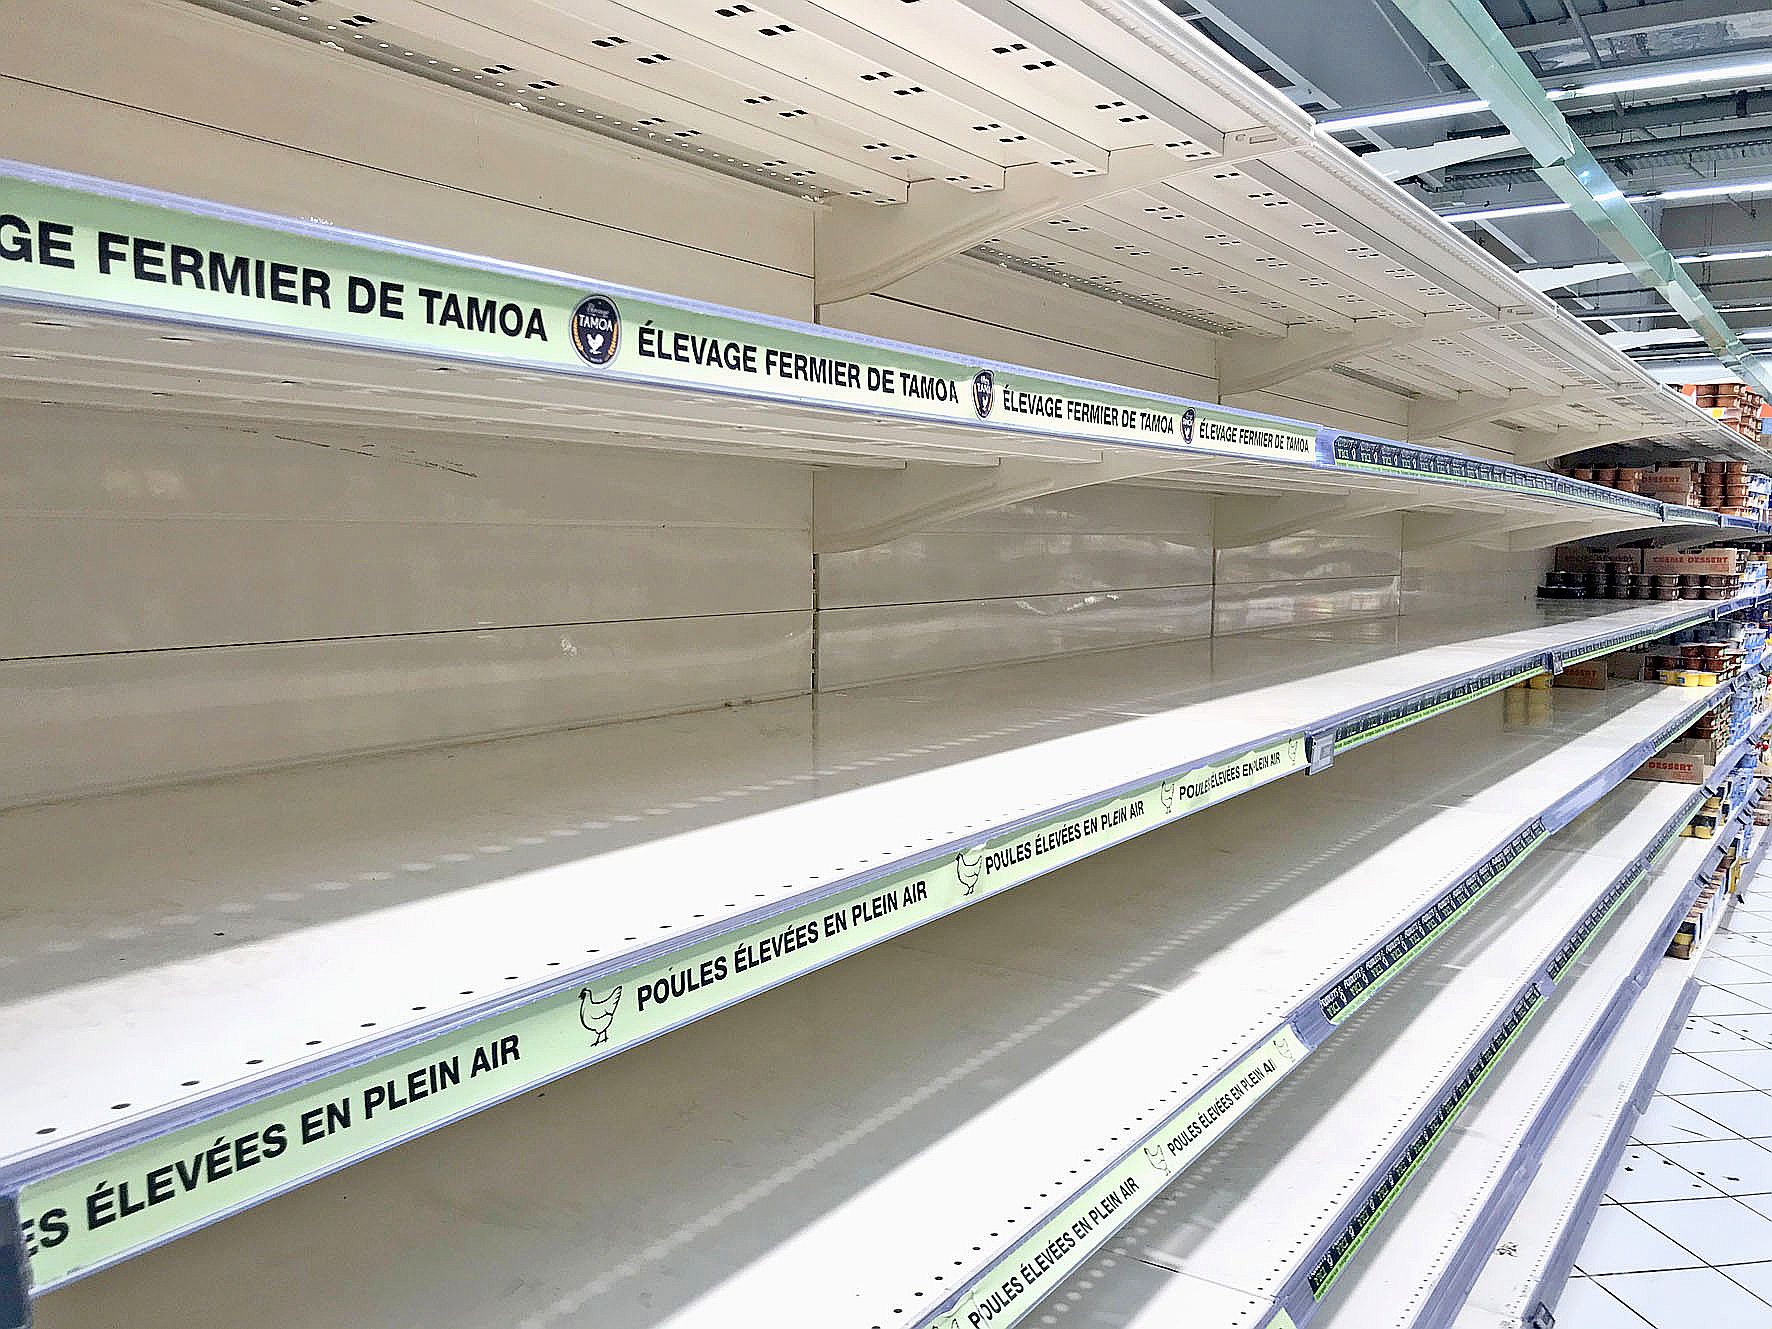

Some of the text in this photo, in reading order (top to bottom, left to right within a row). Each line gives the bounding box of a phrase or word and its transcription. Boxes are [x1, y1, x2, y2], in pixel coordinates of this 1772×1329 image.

[98, 231, 331, 310] FERMIER
[347, 275, 405, 321] DE
[418, 287, 549, 342] TAMOA
[578, 314, 614, 332] TAMOA
[638, 320, 758, 375] ÉLEVAGE
[765, 348, 862, 391] FERMIER
[866, 366, 895, 395] DE
[899, 371, 959, 404] TAMOA
[1002, 383, 1063, 420] ÉLEVAGE
[1067, 400, 1119, 428] FERMIER
[1121, 409, 1137, 430] DE
[1139, 412, 1175, 436] TAMOA
[1199, 417, 1238, 444] ÉLEVAGE
[1239, 428, 1274, 449] FERMIER
[1274, 434, 1285, 450] DE
[1285, 435, 1310, 453] TAMOA
[1269, 752, 1281, 766] AIR
[1648, 761, 1694, 771] DESSERT
[985, 800, 1145, 875] POULES ÉLEVÉES EN PLEIN AIR
[637, 880, 928, 1012] POULES ÉLEVÉES EN PLEIN AIR
[85, 1123, 289, 1231] ÉLEVÉES
[300, 1097, 352, 1145] EN
[363, 1055, 461, 1120] PLEIN
[470, 1036, 521, 1080] AIR
[1166, 1120, 1203, 1157] POULES
[1197, 1092, 1235, 1129] ÉLEVÉES
[1229, 1082, 1245, 1101] EN
[1239, 1067, 1266, 1092] PLEIN
[967, 1177, 1140, 1329] POULES ÉLEVÉES EN PLEIN AIR
